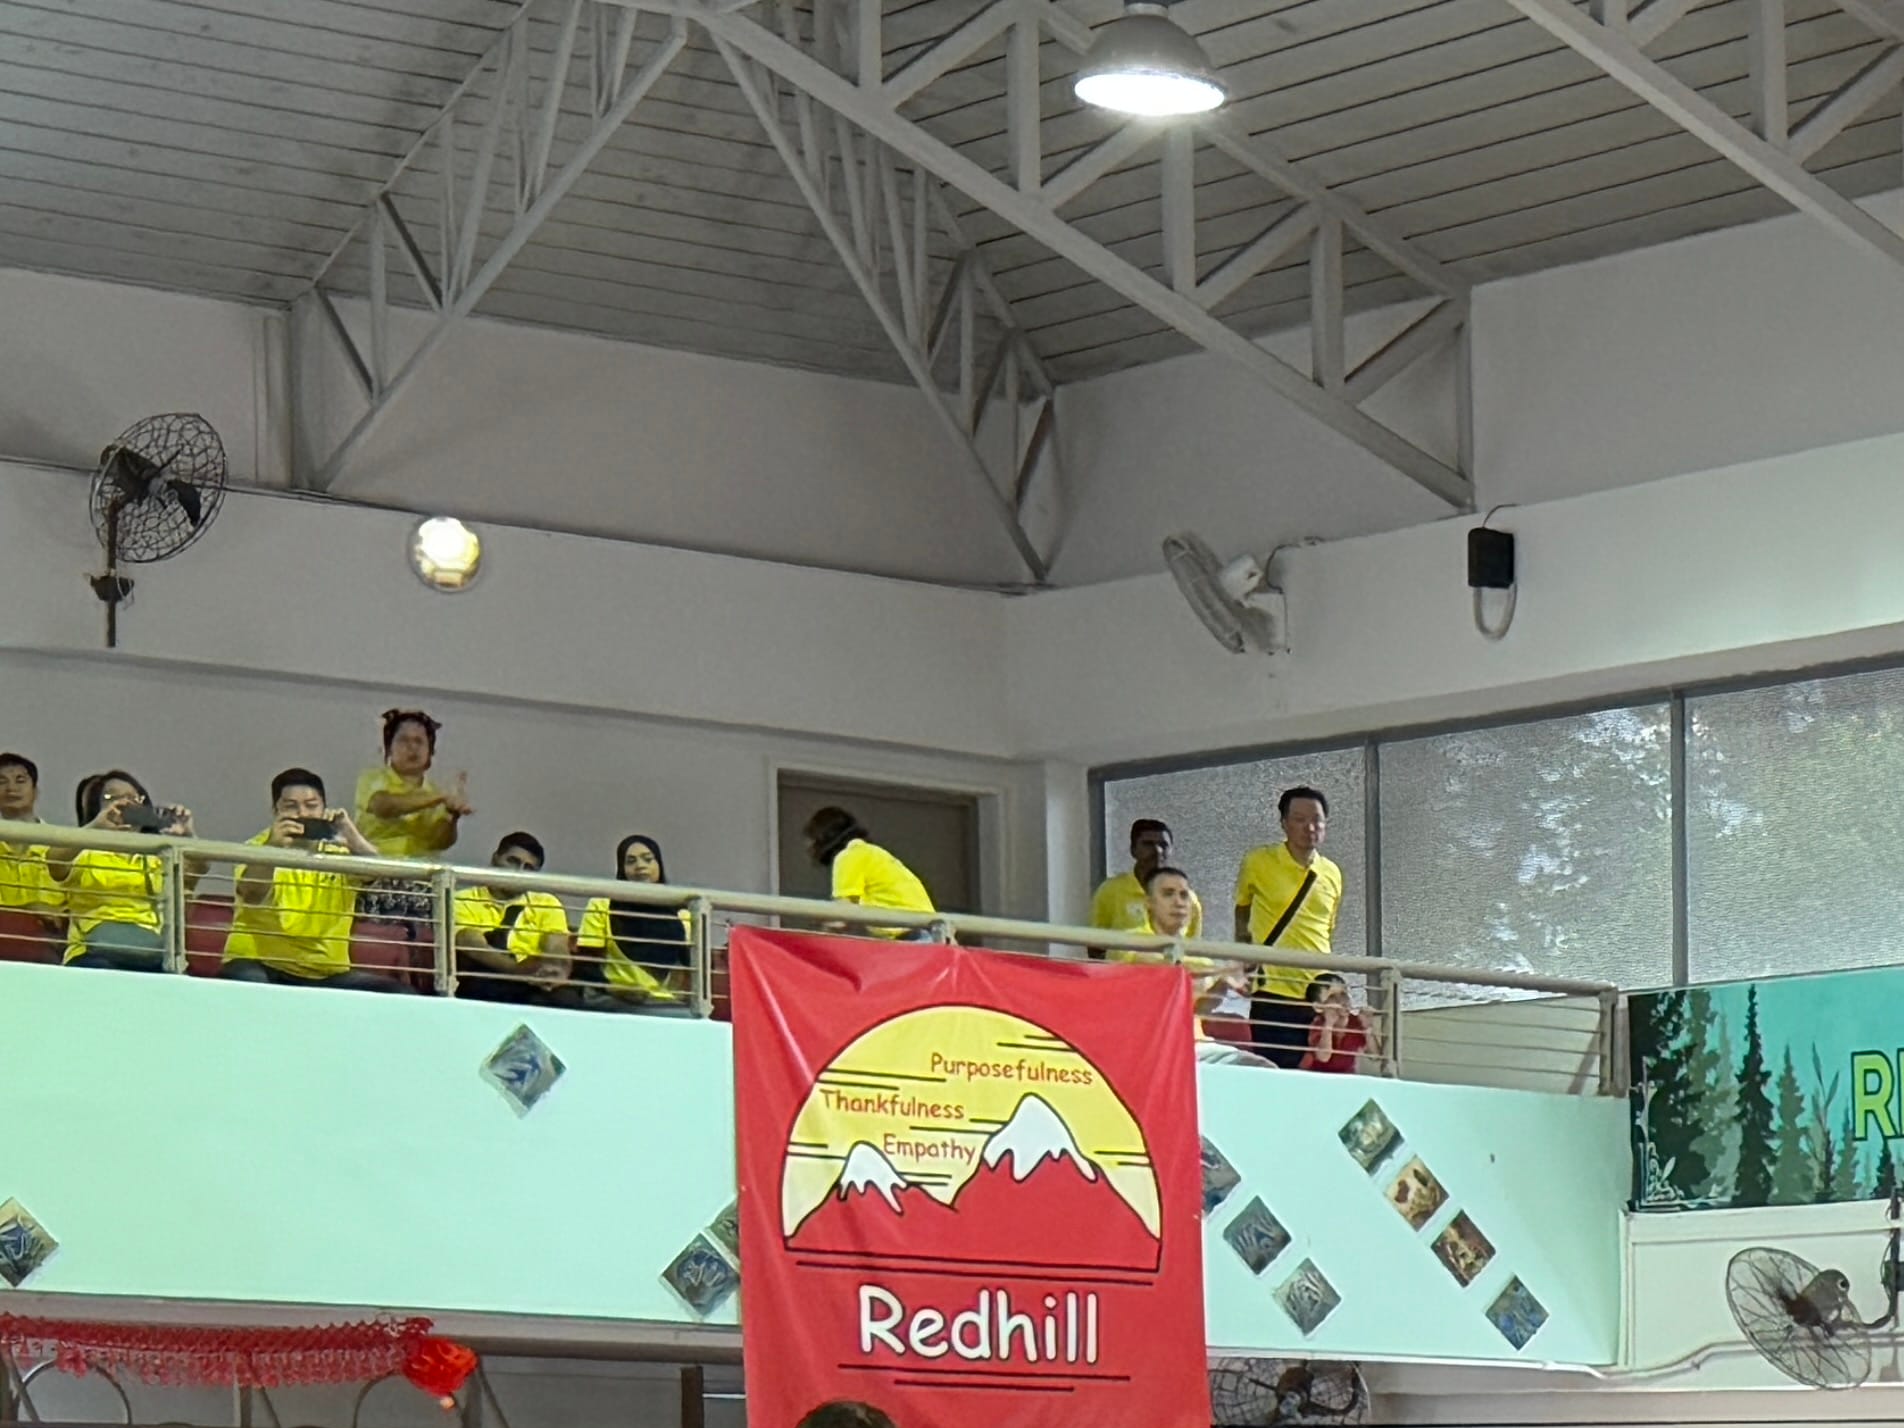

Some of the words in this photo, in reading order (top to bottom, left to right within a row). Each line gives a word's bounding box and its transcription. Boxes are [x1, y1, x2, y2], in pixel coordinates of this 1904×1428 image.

[930, 1052, 1094, 1086] Purposefulness
[820, 1088, 965, 1120] Thankfulness
[882, 1132, 976, 1164] Empathy
[856, 1283, 1101, 1365] Redhill
